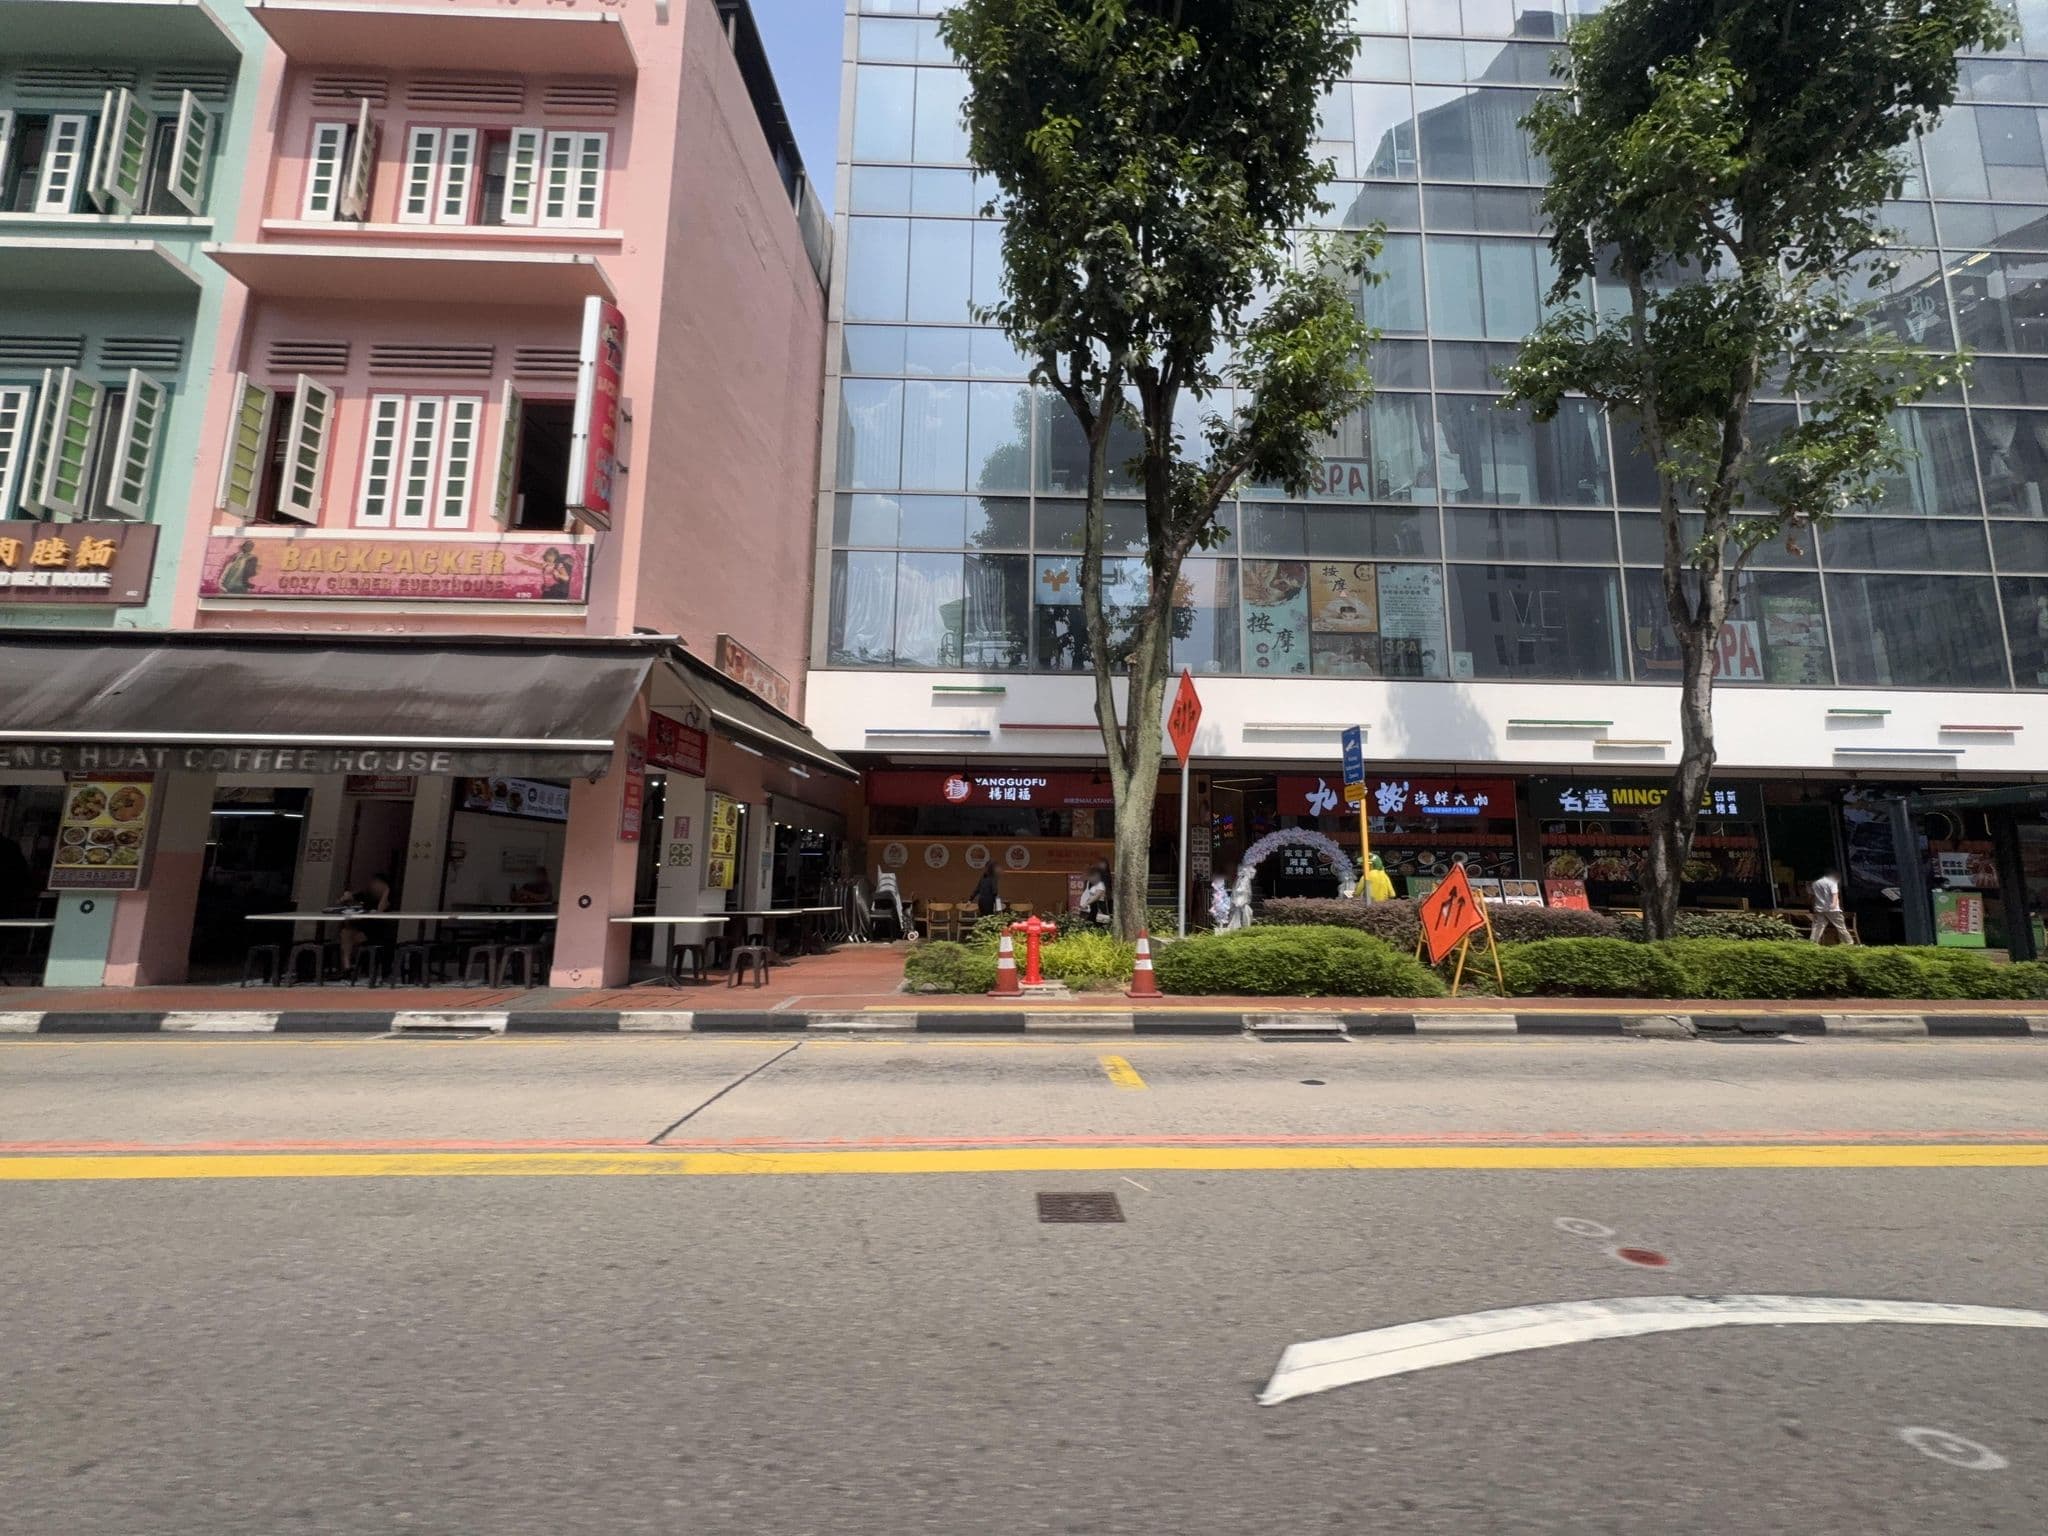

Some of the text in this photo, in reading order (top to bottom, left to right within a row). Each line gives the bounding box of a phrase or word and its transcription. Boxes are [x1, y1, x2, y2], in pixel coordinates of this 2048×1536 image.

[1311, 463, 1366, 496] SPA
[279, 544, 506, 576] BACKPACKER
[1246, 612, 1297, 654] 按摩
[79, 747, 169, 768] HUAT
[184, 748, 318, 770] COFFEE
[333, 751, 450, 772] HOUSE
[975, 778, 1047, 787] YANGGUOFU
[1559, 788, 1610, 813] 名堂
[1612, 788, 1712, 806] MINGG
